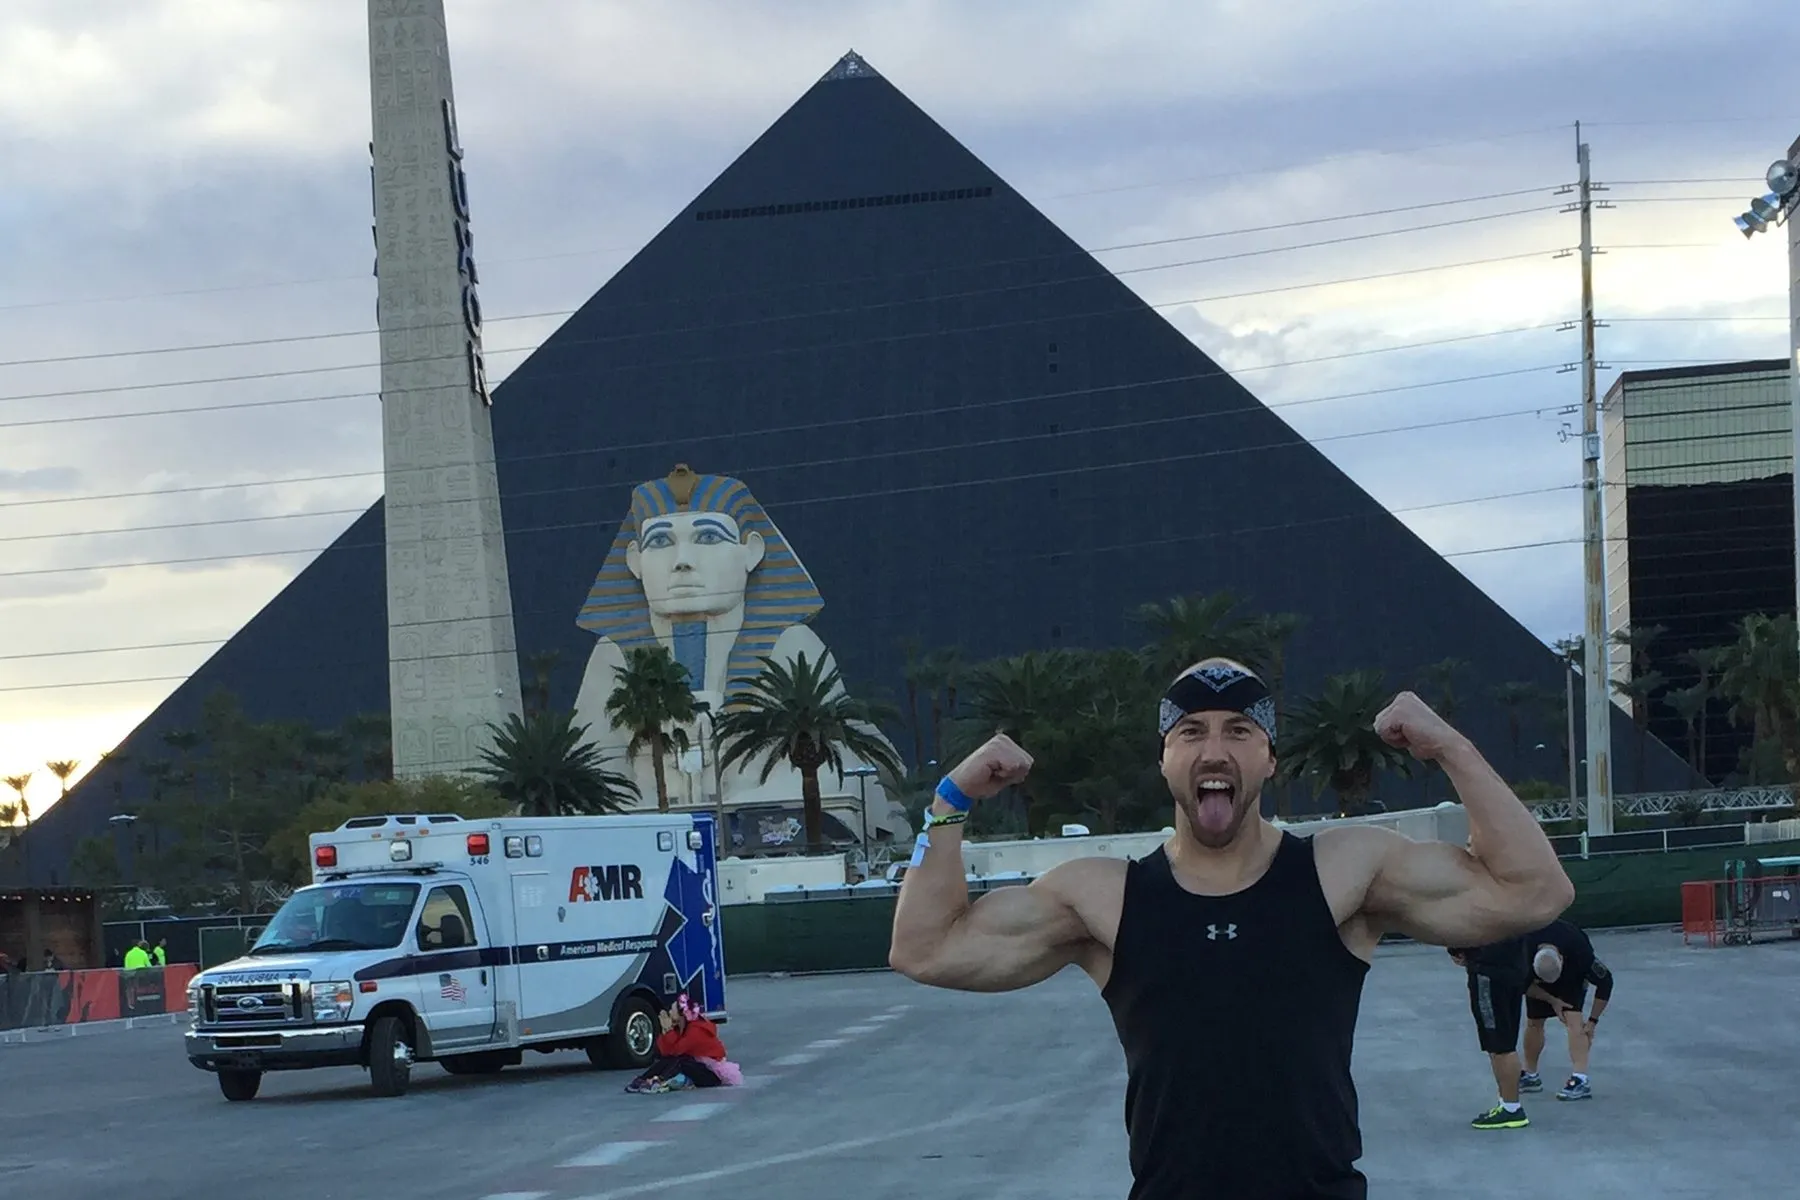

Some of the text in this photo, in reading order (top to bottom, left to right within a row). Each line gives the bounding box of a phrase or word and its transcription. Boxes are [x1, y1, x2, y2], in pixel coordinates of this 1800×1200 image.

[443, 98, 492, 406] LUXOR
[469, 856, 490, 866] 546
[569, 864, 643, 902] AMR
[561, 940, 658, 955] American Medical Response
